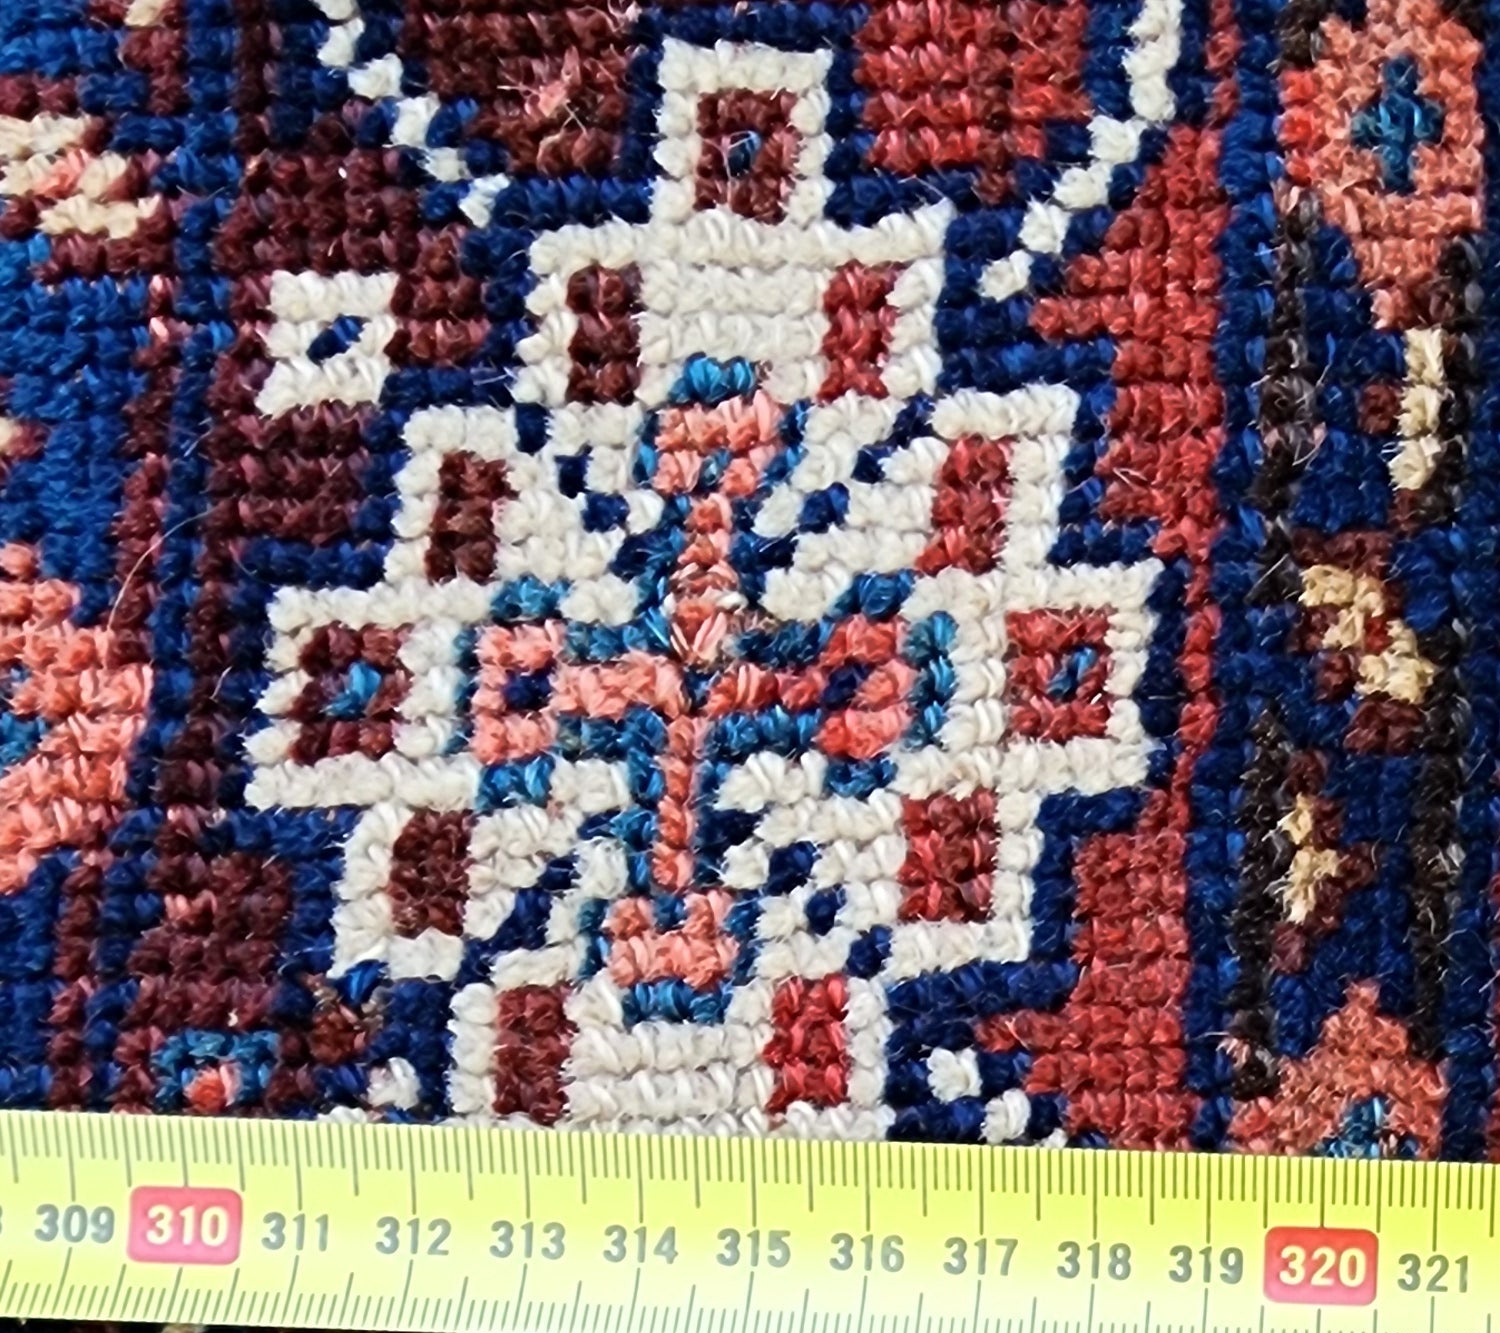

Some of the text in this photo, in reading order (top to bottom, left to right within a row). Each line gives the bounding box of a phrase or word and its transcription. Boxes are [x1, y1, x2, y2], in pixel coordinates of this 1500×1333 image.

[34, 1203, 116, 1244] 309
[145, 1205, 230, 1247] 310
[261, 1211, 329, 1252] 311
[375, 1215, 451, 1256] 312
[489, 1221, 565, 1261] 313
[603, 1225, 678, 1264] 314
[716, 1228, 791, 1269] 315
[829, 1233, 905, 1273] 316
[943, 1237, 1018, 1277] 317
[1057, 1241, 1131, 1280] 318
[1168, 1245, 1244, 1285] 319
[1279, 1245, 1366, 1287] 320
[1397, 1253, 1469, 1293] 321
